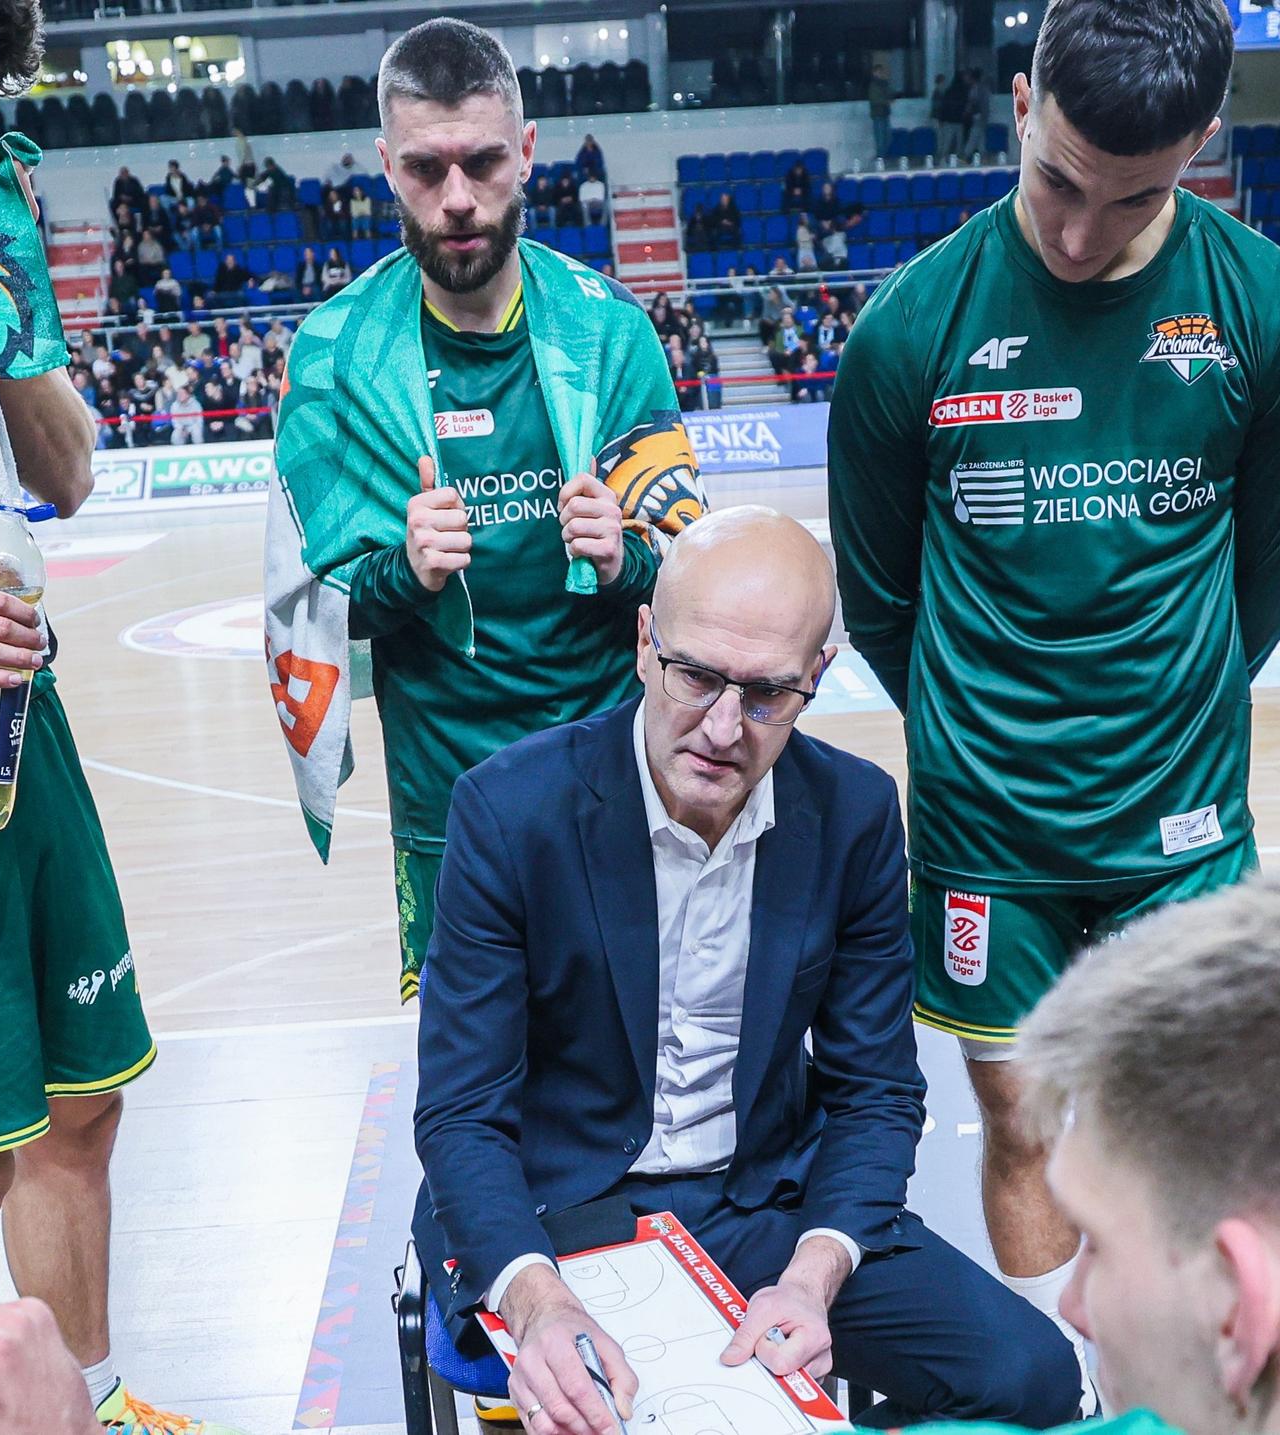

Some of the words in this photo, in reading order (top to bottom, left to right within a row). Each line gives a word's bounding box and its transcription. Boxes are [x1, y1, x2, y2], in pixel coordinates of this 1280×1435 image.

[968, 335, 1029, 370] 4F
[1033, 392, 1074, 404] Basket
[933, 399, 997, 420] ORLEN
[1033, 404, 1058, 417] Liga
[451, 413, 486, 424] Basket
[453, 424, 474, 434] Liga
[1029, 457, 1202, 491] WODOCIĄGI
[1033, 494, 1141, 524] ZIELONA
[1148, 482, 1217, 516] GÓRA
[950, 889, 985, 904] ORLEN
[948, 951, 981, 968] Basket
[953, 963, 974, 976] Liga
[668, 1233, 701, 1268] ZASTAL
[694, 1262, 732, 1305] ZIELONA
